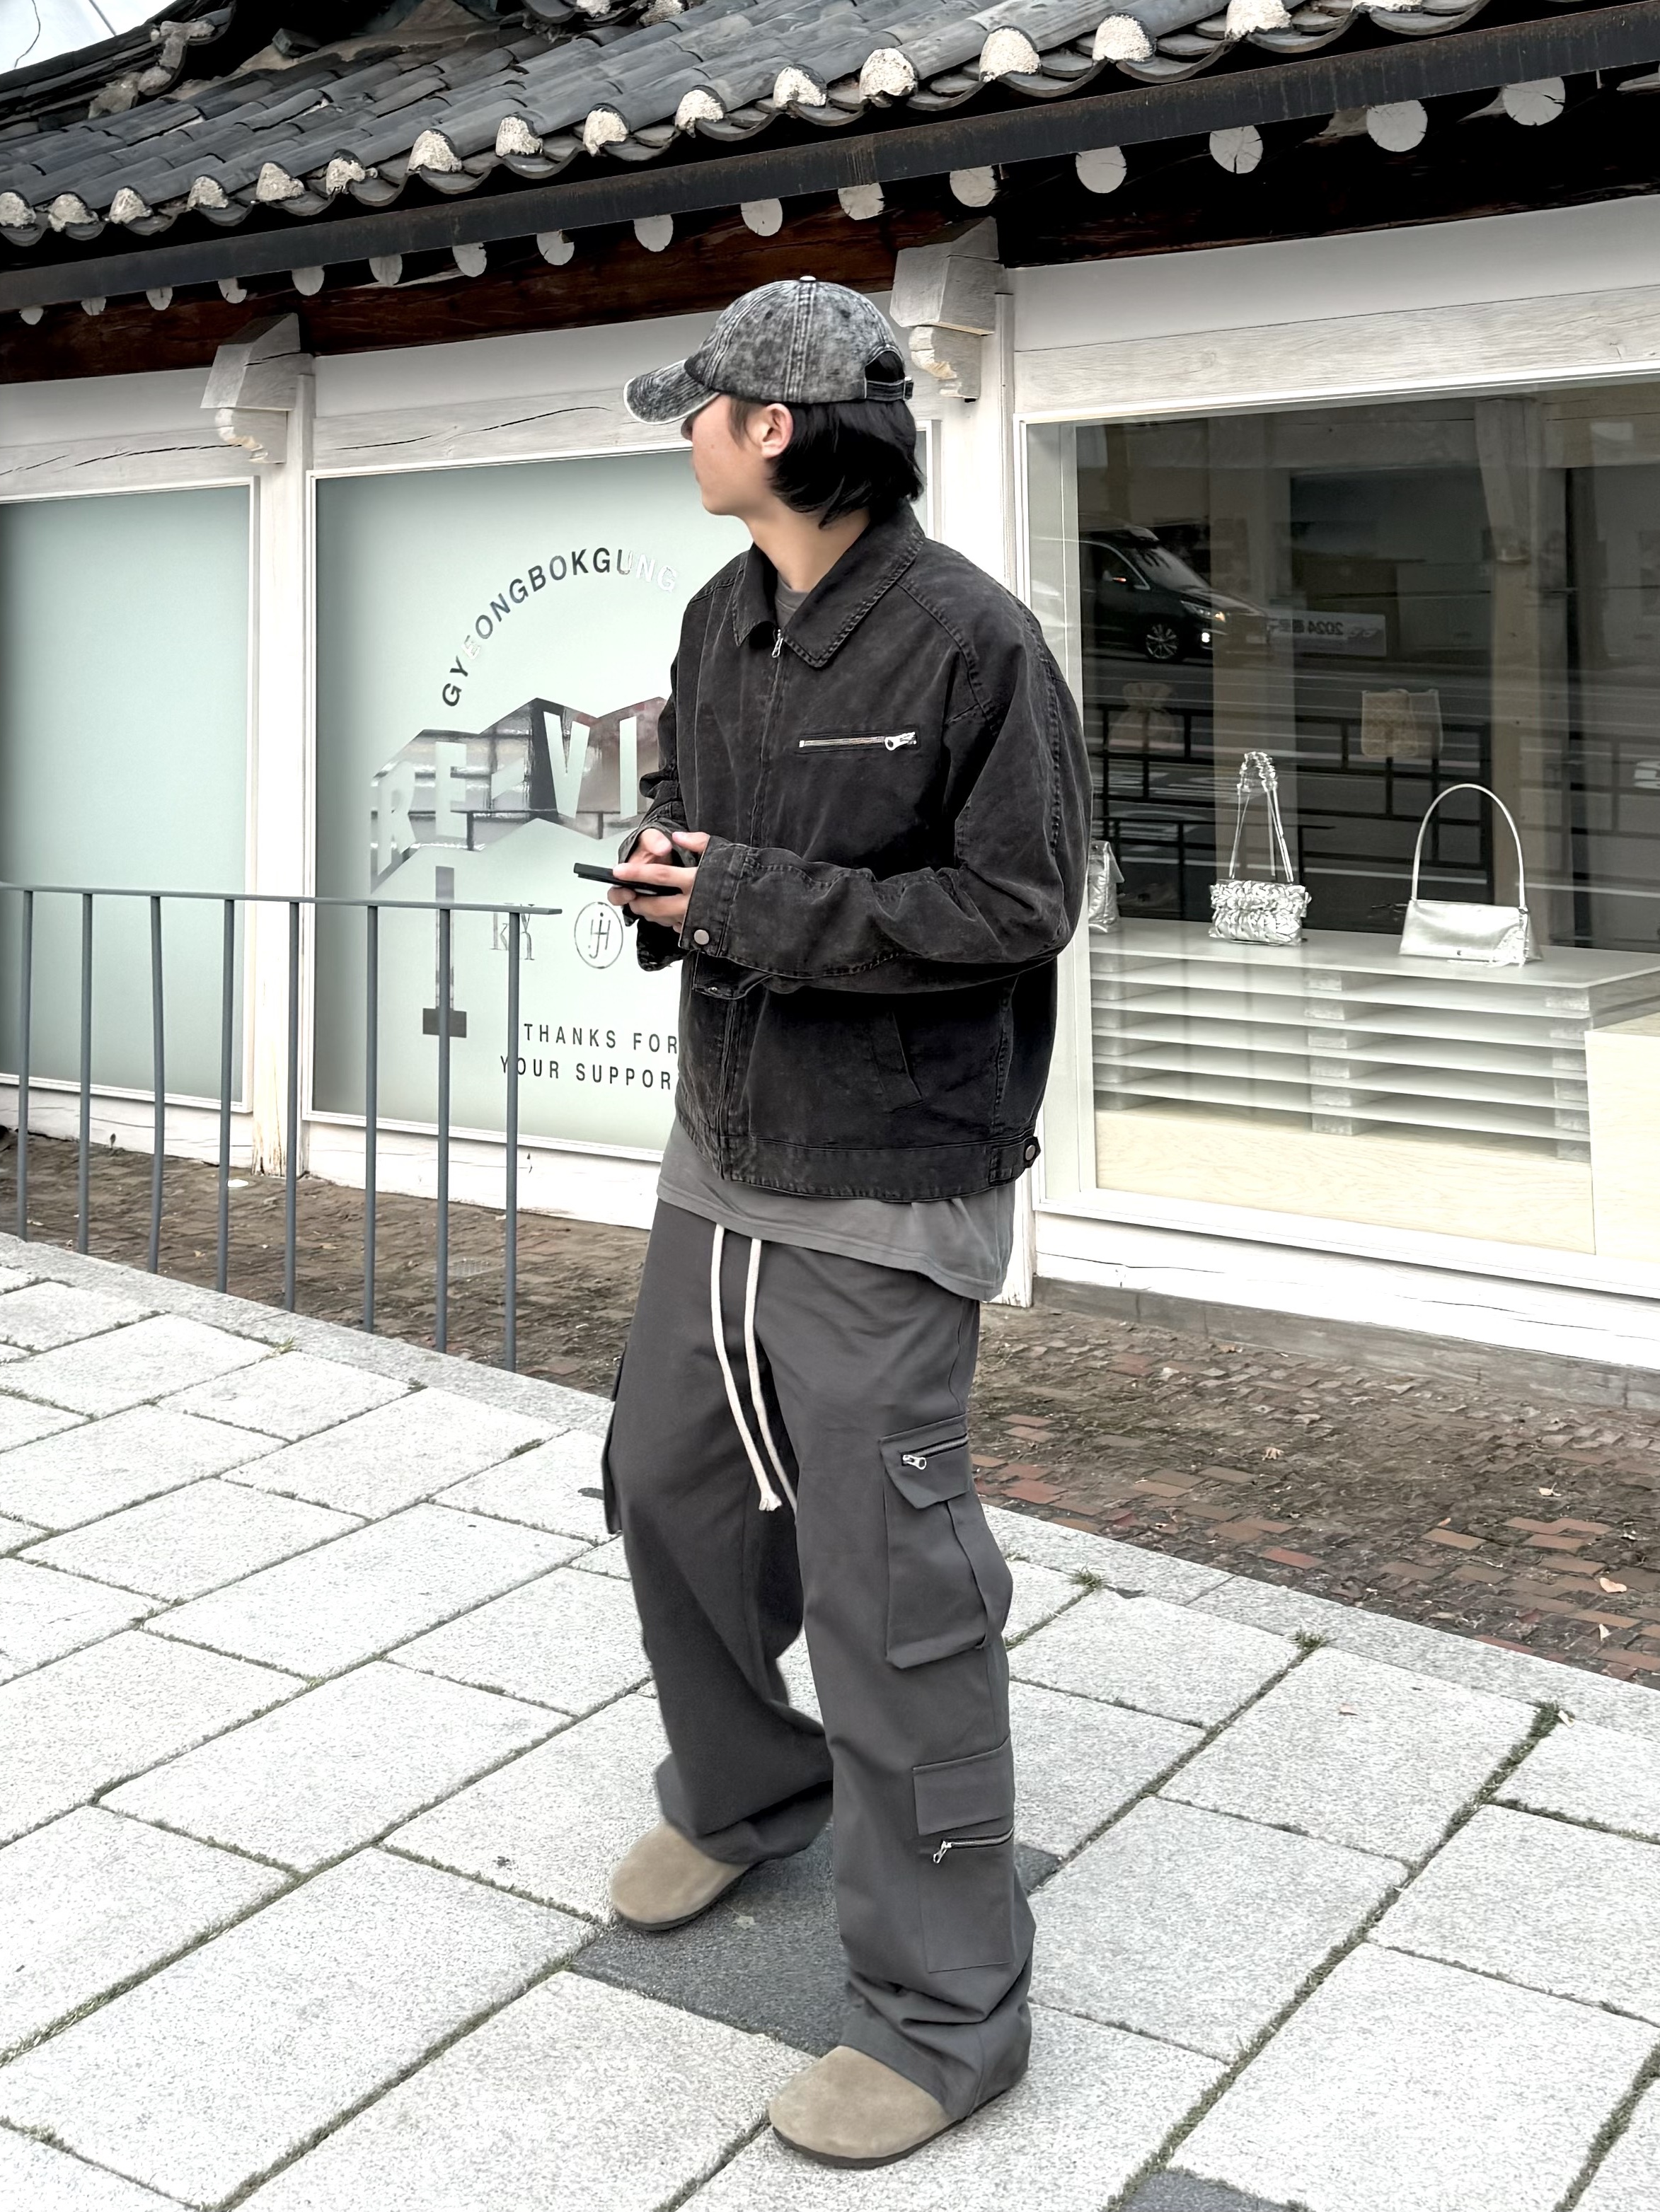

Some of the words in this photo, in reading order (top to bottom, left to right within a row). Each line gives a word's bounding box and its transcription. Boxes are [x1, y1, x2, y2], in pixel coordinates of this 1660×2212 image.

[442, 548, 677, 707] GYEONGBOKGUNG
[377, 711, 637, 876] RE-VI
[500, 1055, 559, 1079] YOUR
[576, 1063, 671, 1089] SUPPOR
[524, 1024, 616, 1048] THANKS
[633, 1033, 677, 1054] FOR
